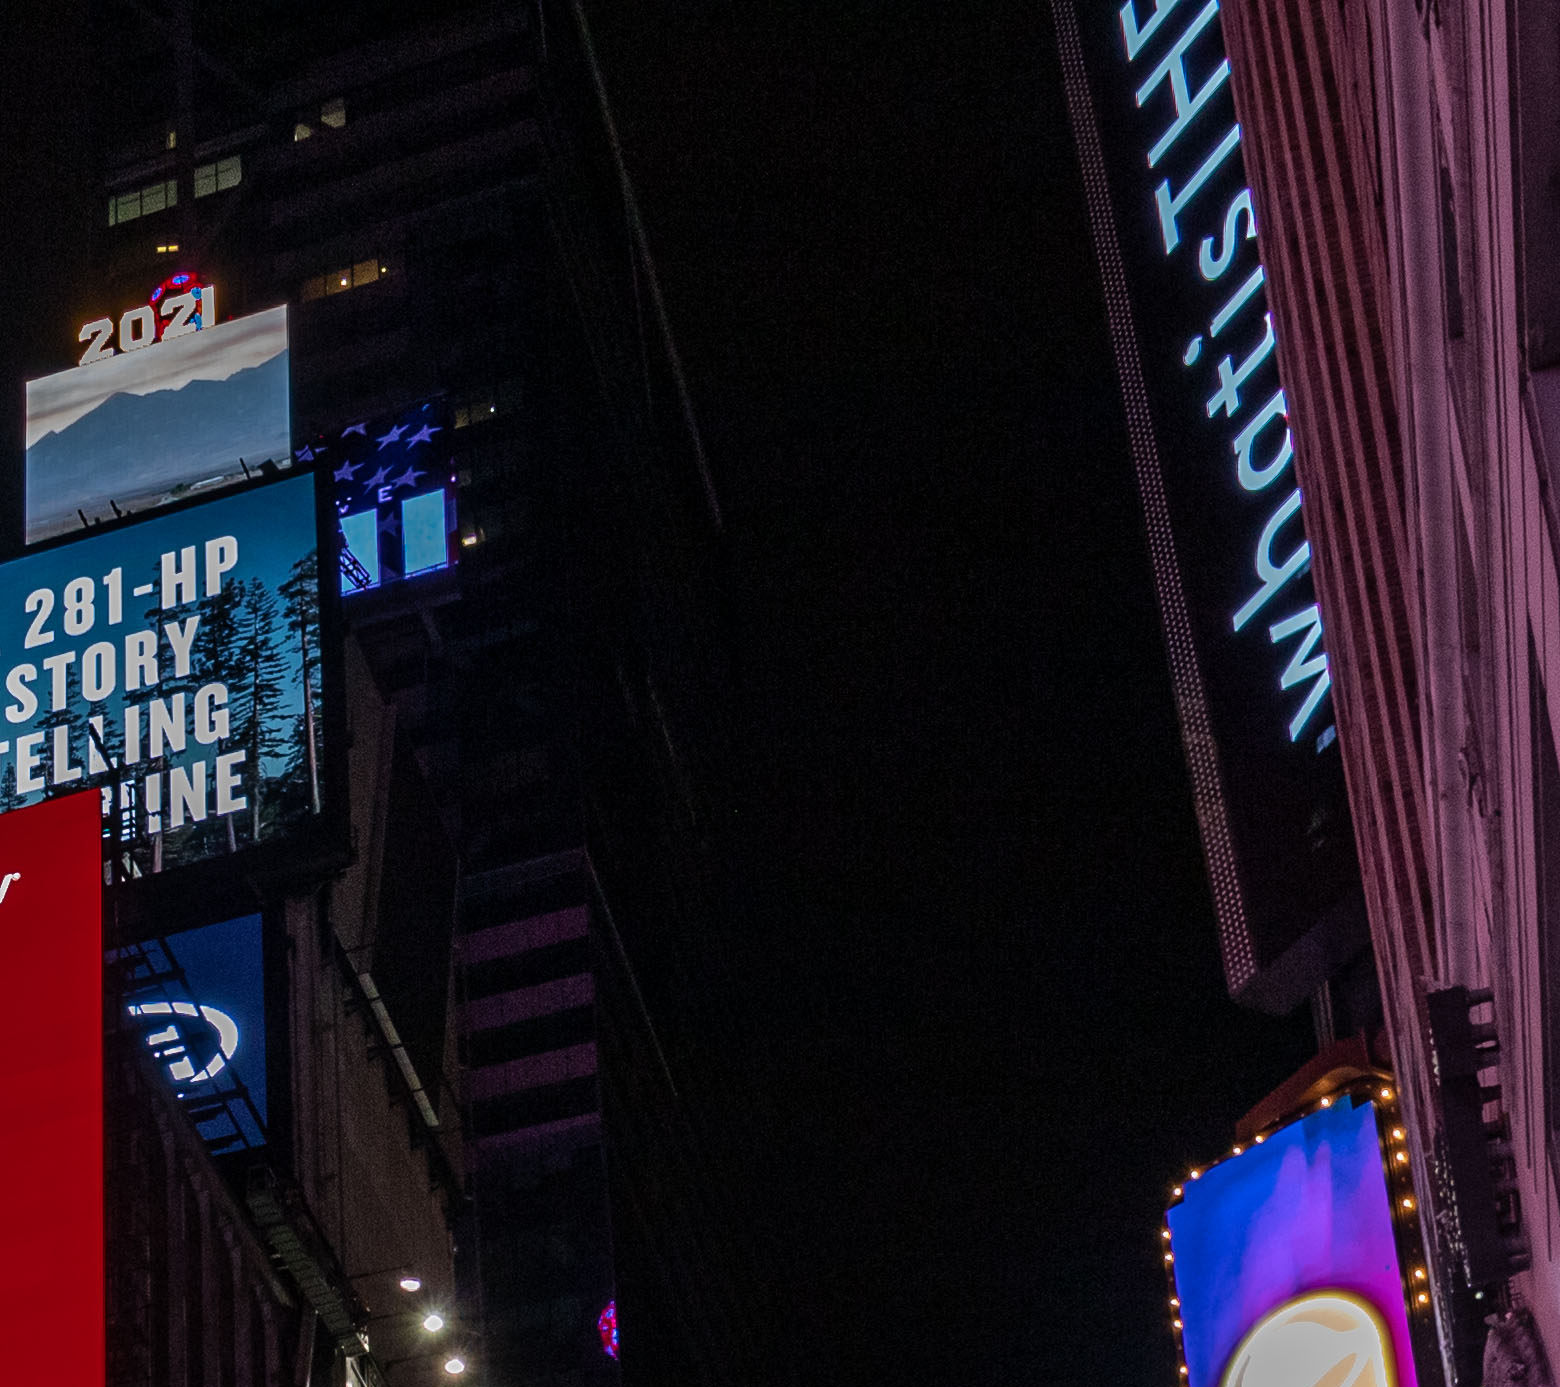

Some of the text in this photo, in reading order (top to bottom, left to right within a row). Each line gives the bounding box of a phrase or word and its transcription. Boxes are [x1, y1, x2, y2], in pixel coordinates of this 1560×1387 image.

[78, 285, 217, 367] 2021
[23, 535, 240, 651] 281-HP
[4, 616, 202, 725] STORY
